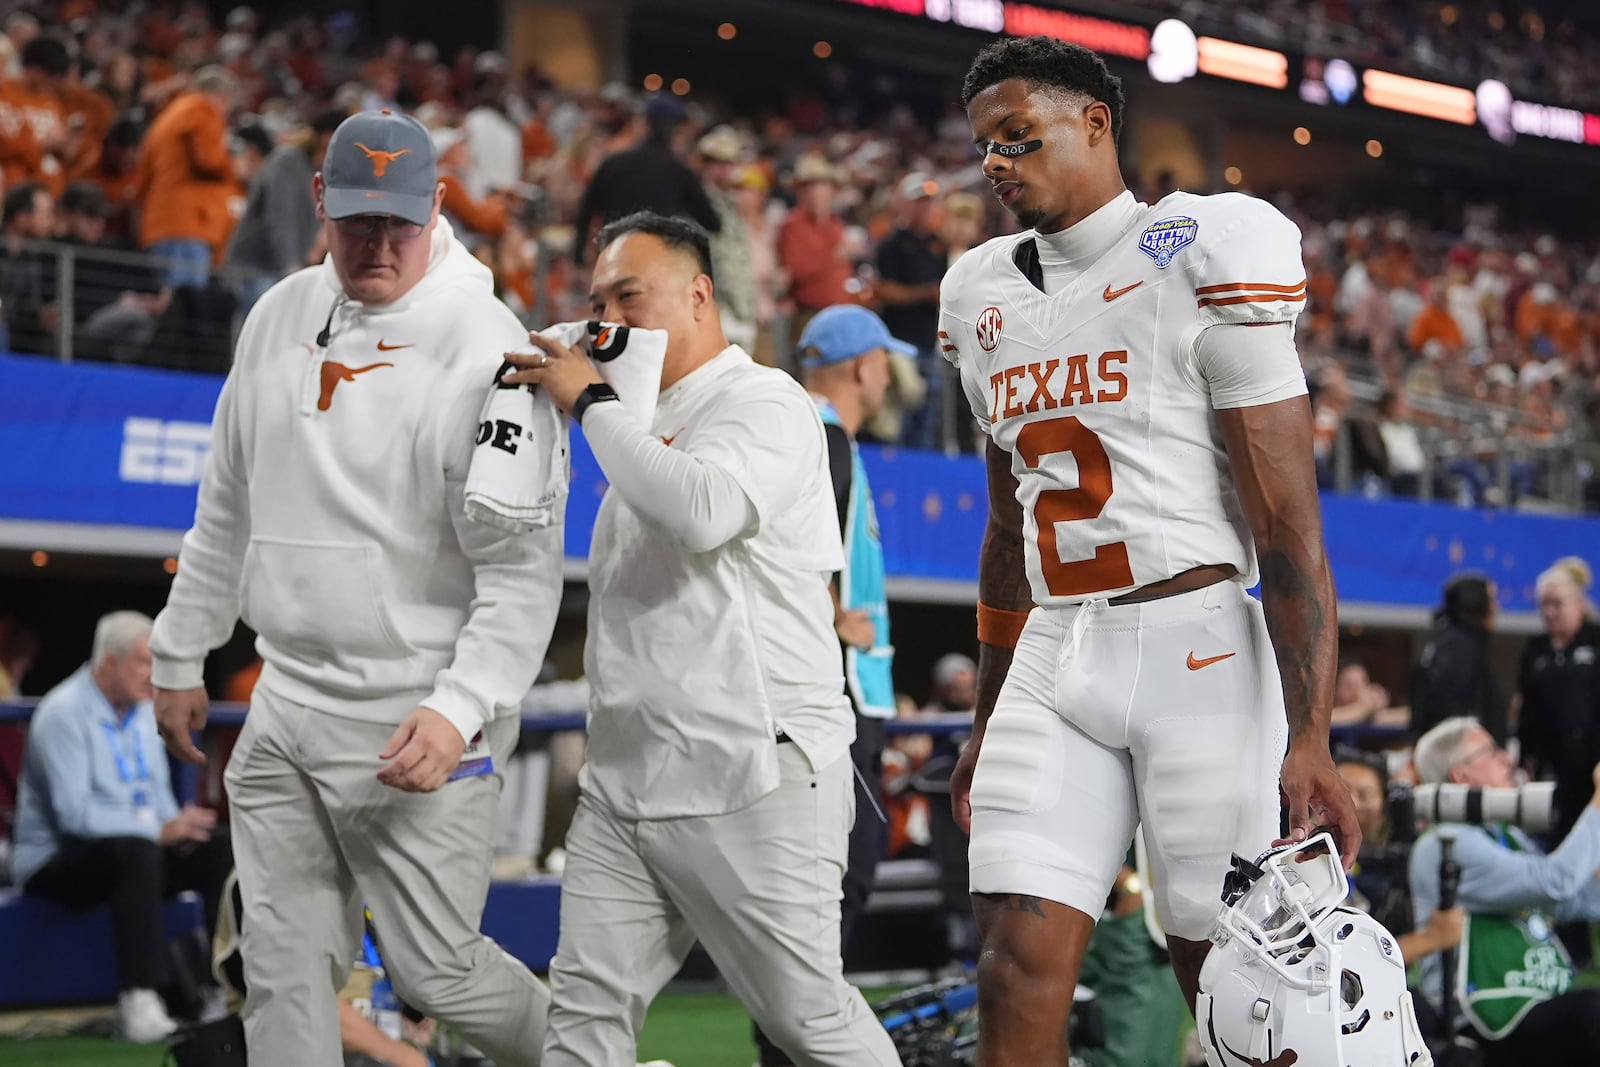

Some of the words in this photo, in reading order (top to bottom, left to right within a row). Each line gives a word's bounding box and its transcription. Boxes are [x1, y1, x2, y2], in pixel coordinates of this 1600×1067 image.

[1000, 145, 1026, 154] GOD
[1143, 226, 1193, 247] COTTON
[1150, 237, 1182, 249] BOWL
[977, 307, 1002, 350] SEC
[990, 350, 1127, 424] TEXAS
[1016, 416, 1134, 596] 2
